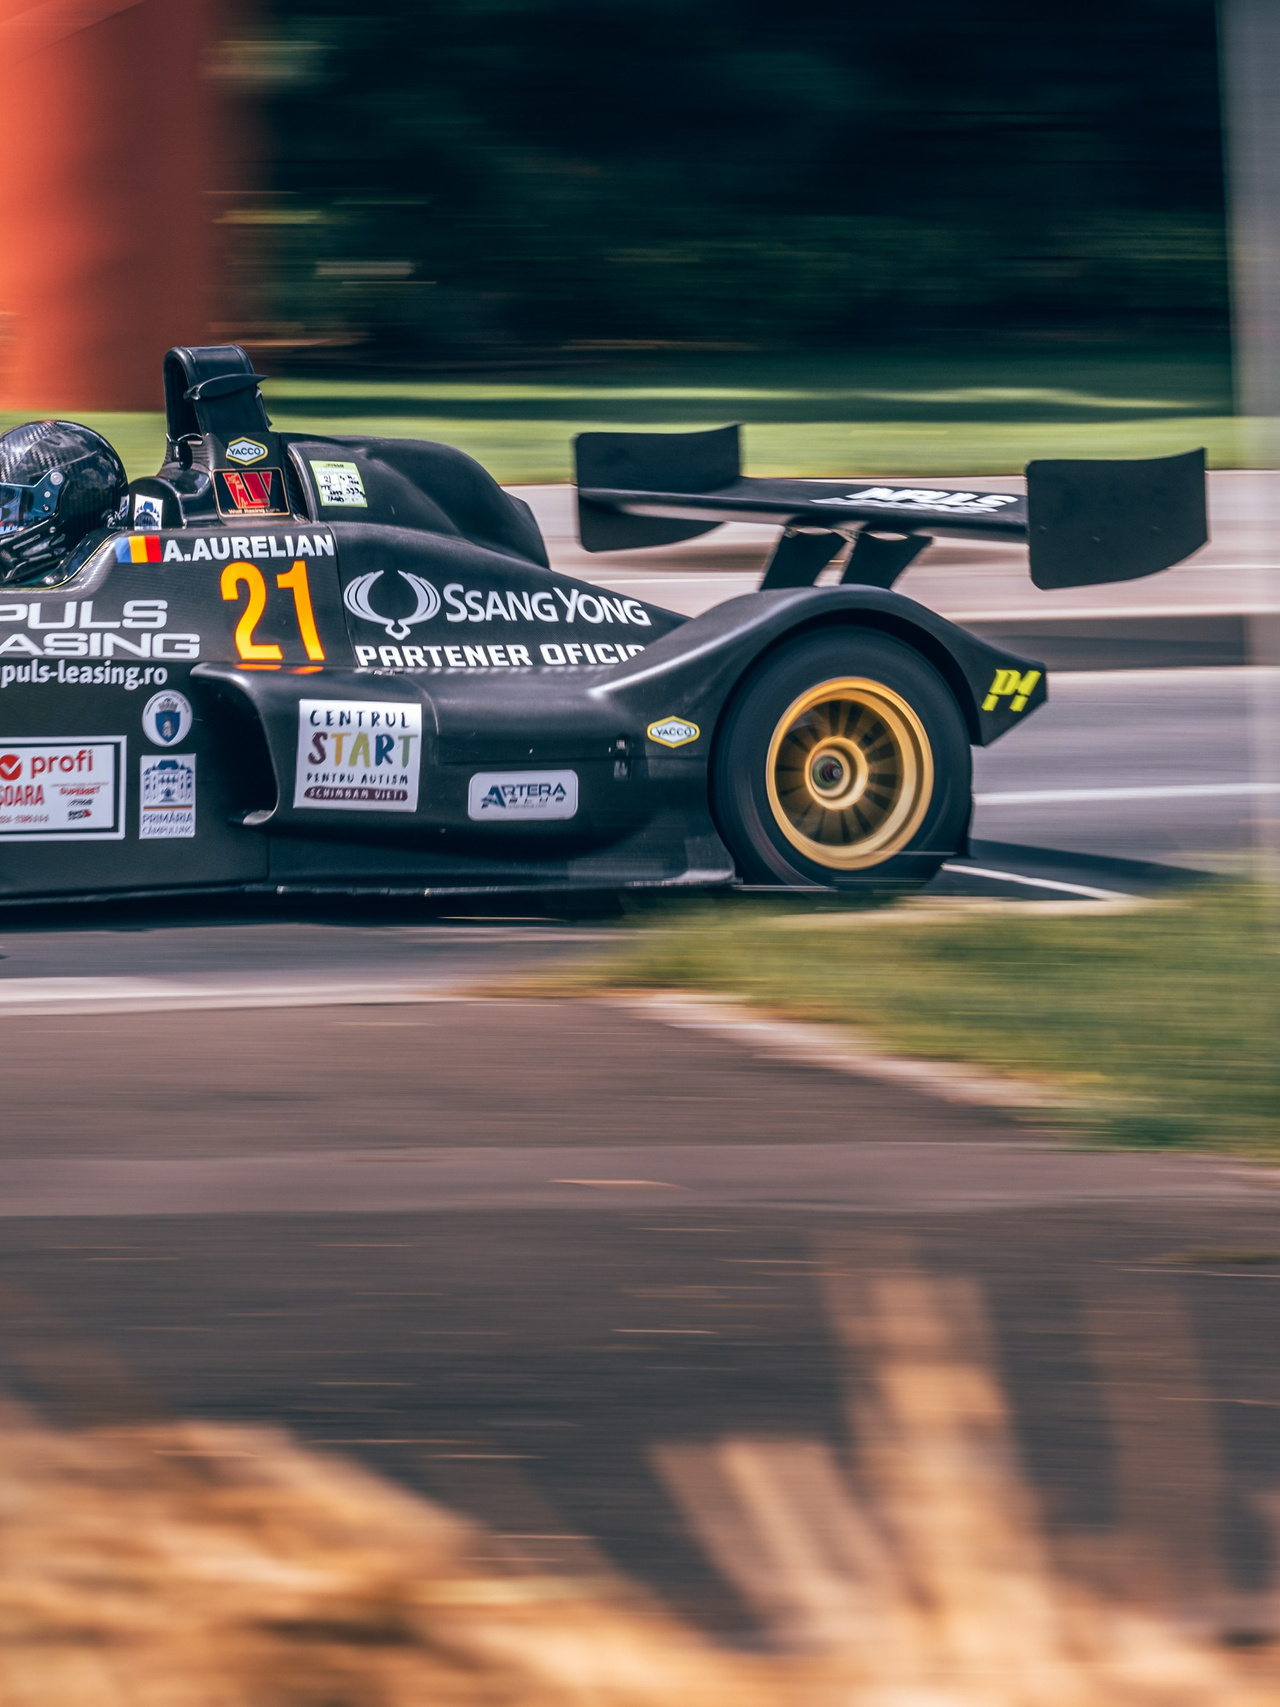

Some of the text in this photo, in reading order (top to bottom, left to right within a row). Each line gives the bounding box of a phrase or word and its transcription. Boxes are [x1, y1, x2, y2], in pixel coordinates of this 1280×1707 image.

[229, 447, 261, 456] YACCO
[163, 534, 335, 562] A.AURELIAN
[220, 560, 325, 661] 21
[355, 644, 533, 667] PARTENER
[310, 709, 410, 728] CENTRUL
[656, 728, 692, 737] YACCO
[307, 731, 419, 769] START
[31, 749, 94, 779] profi
[306, 772, 408, 785] PENTRU AUTISM
[480, 782, 567, 810] ARTERA
